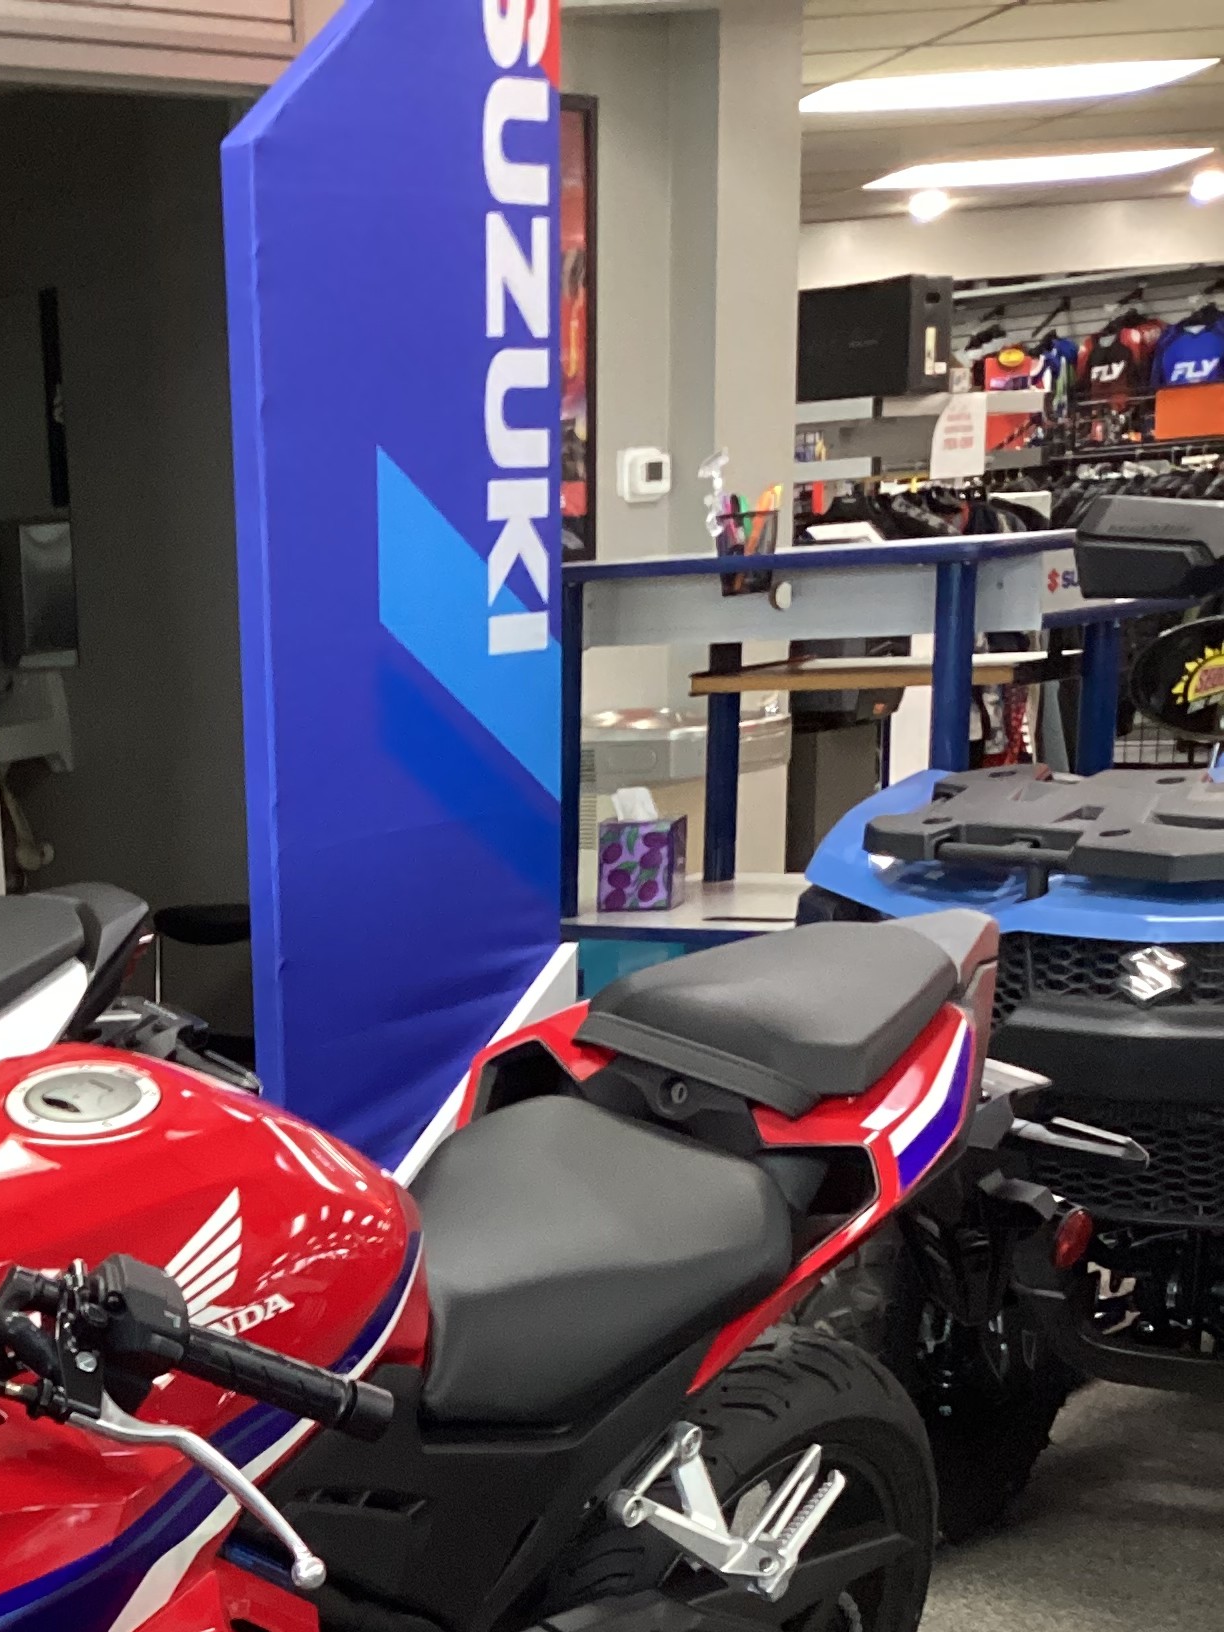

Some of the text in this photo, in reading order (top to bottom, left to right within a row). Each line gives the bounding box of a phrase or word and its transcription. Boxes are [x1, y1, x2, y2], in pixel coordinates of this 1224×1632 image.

[482, 0, 550, 655] SUZUKI
[1090, 360, 1126, 382] FLY
[1171, 357, 1220, 382] FLY
[205, 1292, 296, 1337] NDA
